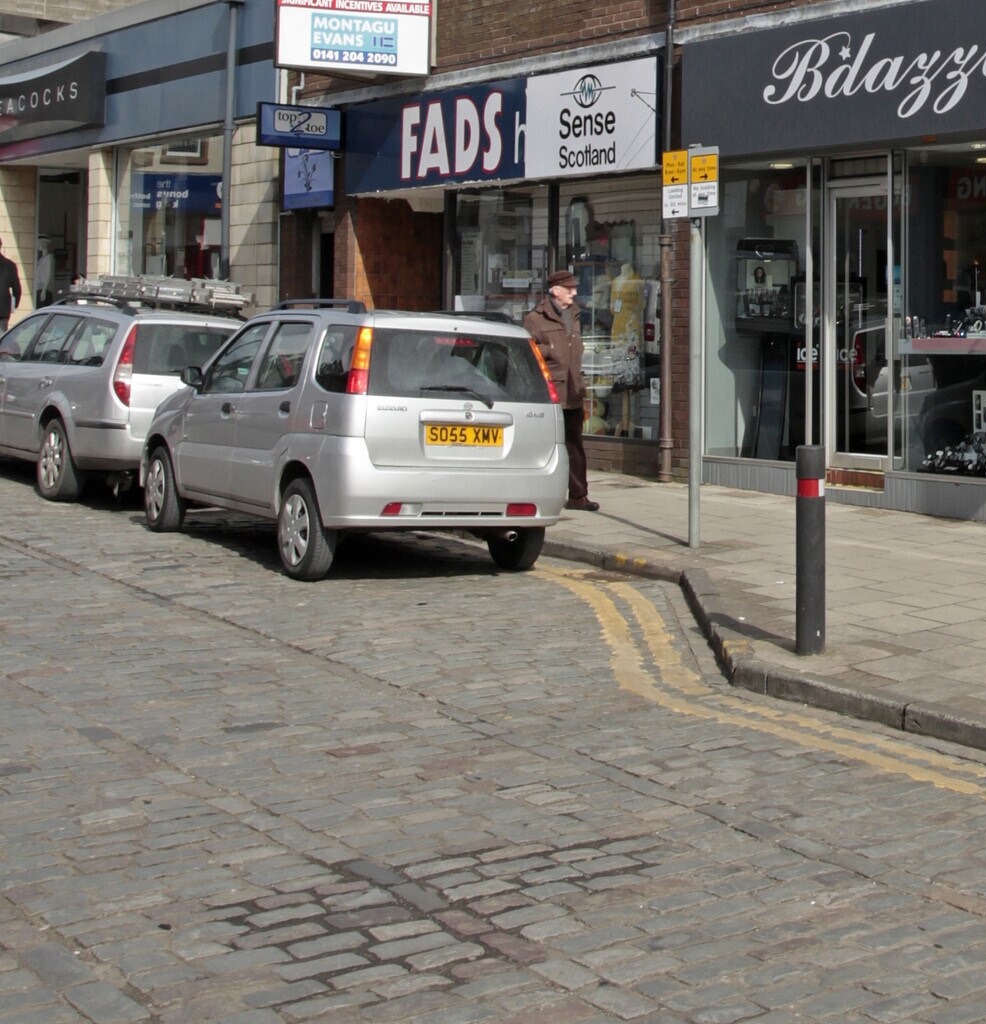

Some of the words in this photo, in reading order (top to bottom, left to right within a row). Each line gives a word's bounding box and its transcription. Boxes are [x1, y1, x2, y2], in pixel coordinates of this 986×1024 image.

[385, 3, 430, 15] AVAILABLE
[314, 17, 395, 34] MONTAGU
[313, 31, 364, 47] EVANS
[313, 49, 339, 61] 0141
[342, 51, 364, 62] 204
[367, 52, 396, 64] 2090
[559, 108, 616, 140] Sense
[401, 91, 502, 180] FADS
[559, 141, 616, 169] Scotland
[473, 428, 500, 444] XMV
